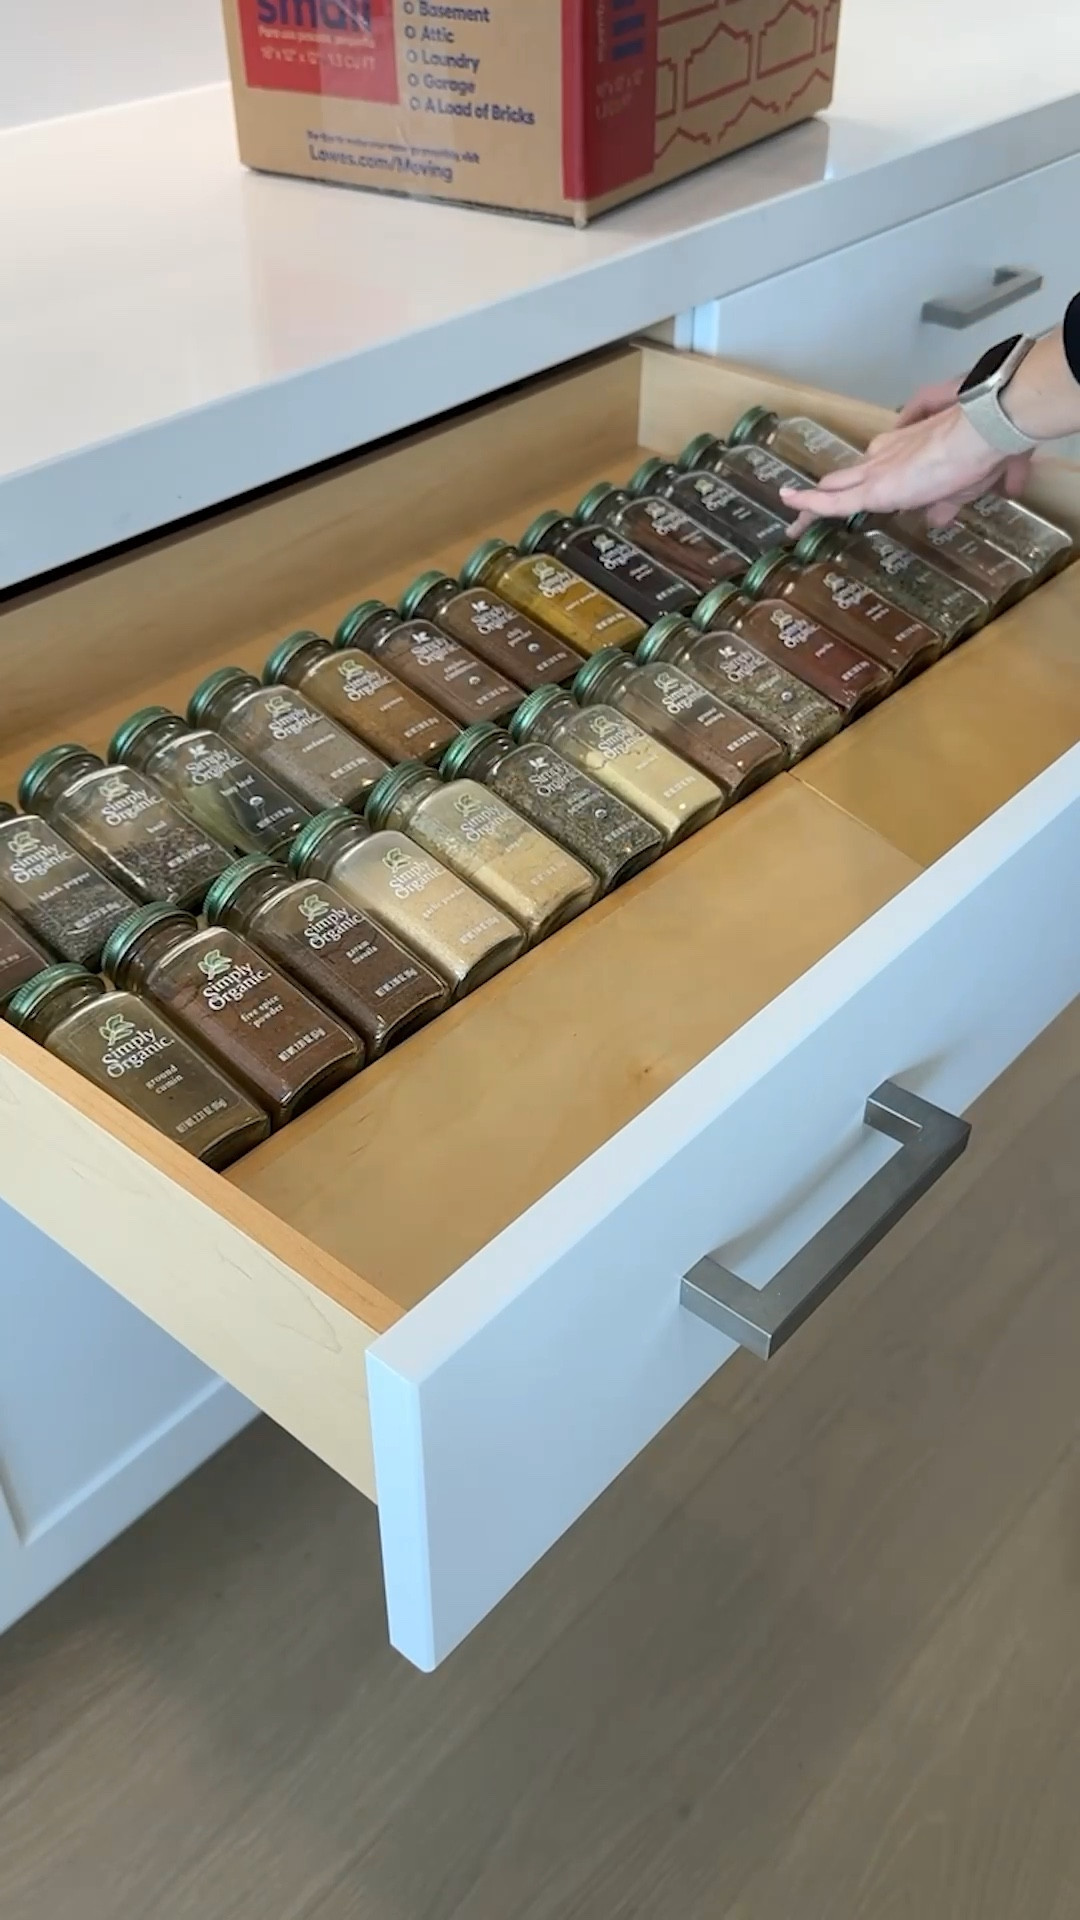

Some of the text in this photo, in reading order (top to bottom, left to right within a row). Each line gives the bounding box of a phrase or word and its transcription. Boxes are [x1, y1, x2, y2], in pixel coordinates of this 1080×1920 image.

[419, 2, 490, 22] Basement
[420, 26, 455, 43] Attic
[422, 51, 480, 73] Laundry
[423, 72, 476, 95] Garage
[425, 98, 536, 125] A Load of Bricks
[309, 144, 454, 183] Lowes.com/Moving
[101, 789, 149, 815] Simply
[10, 844, 59, 873] Simply
[389, 859, 431, 890] Simply
[304, 907, 351, 940] Simply
[202, 962, 255, 996] Simply
[240, 995, 281, 1023] five spice
[253, 1003, 285, 1029] powder
[102, 1028, 157, 1065] Simply
[145, 1064, 178, 1089] ground
[155, 1073, 184, 1095] cumin
